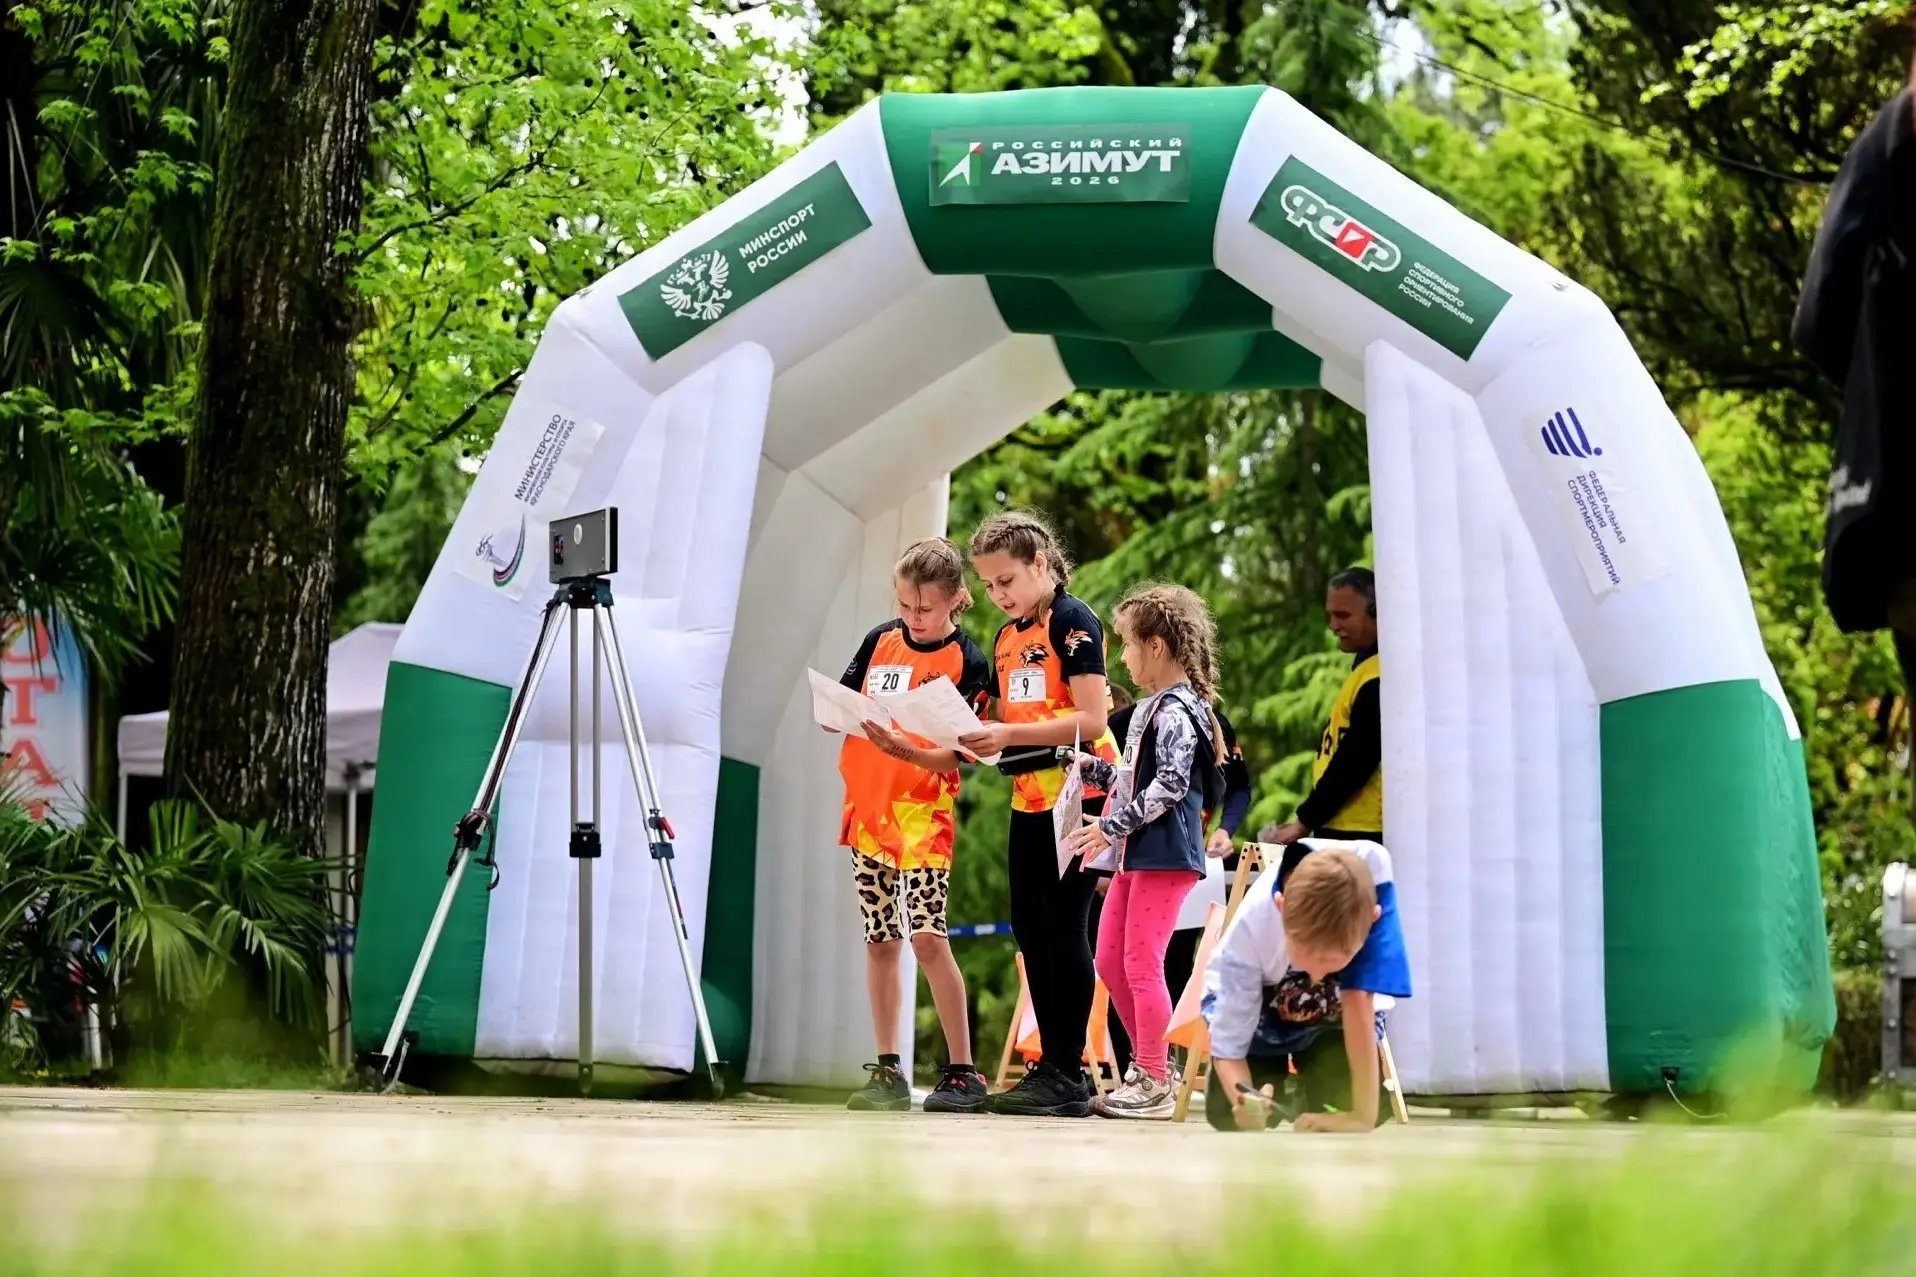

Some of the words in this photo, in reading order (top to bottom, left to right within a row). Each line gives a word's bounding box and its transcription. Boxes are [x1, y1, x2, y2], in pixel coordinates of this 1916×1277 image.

[991, 150, 1181, 175] АЗИМУТ
[992, 138, 1182, 150] РОССИЙСКИЙ
[1051, 176, 1120, 186] 2026
[738, 203, 816, 258] МИНСПОРТ
[747, 230, 808, 274] РОССИИ
[1398, 283, 1432, 308] РОССИИ
[1408, 269, 1465, 307] СПОРТИВНОГО
[1413, 262, 1460, 294] ФЕДЕРАЦИЯ
[1403, 276, 1475, 324] ОРИЕНТИРОВАНИЯ
[514, 414, 562, 500] МИНИСТЕРСТВО
[529, 440, 566, 506] КРАСНОДАРСКОГО
[562, 420, 576, 441] КРАЯ
[1576, 475, 1607, 528] ДИРЕКЦИЯ
[1588, 470, 1626, 544] ФЕДЕРАЛЬНАЯ
[1567, 479, 1621, 585] СПОРТМЕРОПРИЯТИЙ
[881, 672, 900, 690] 20
[1022, 677, 1029, 696] 9
